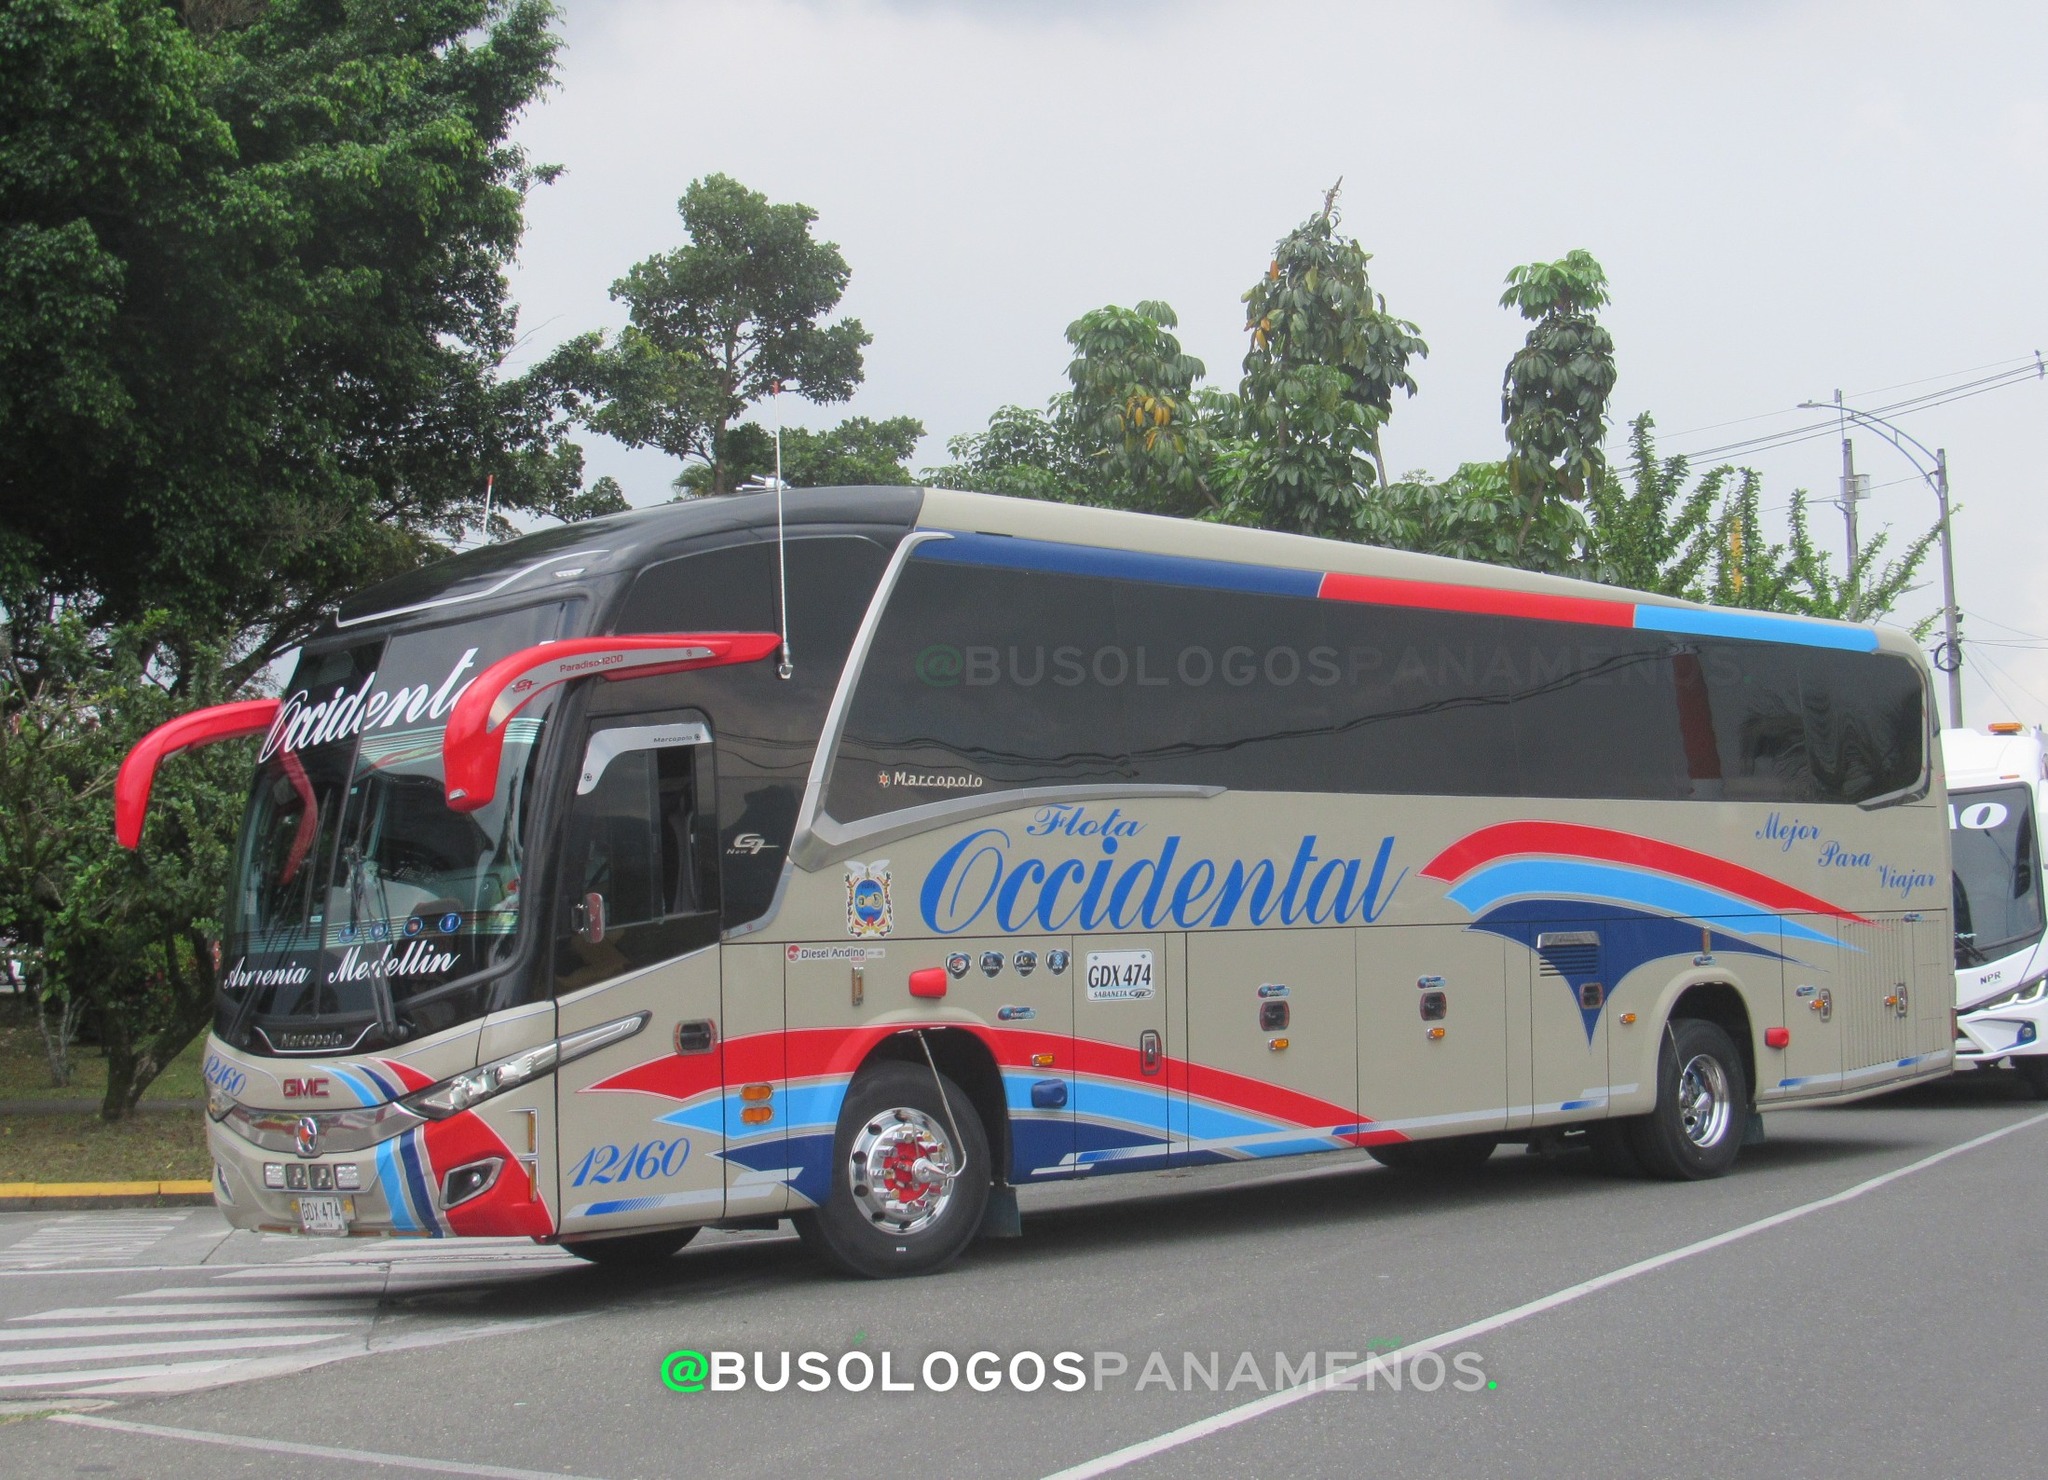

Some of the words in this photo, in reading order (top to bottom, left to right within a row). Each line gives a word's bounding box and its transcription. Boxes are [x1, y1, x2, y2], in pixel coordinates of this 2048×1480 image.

[560, 660, 600, 673] Paradiso
[258, 647, 480, 764] Occident
[653, 736, 693, 744] Marcopolo
[893, 771, 983, 789] Marcopolo
[1026, 803, 1150, 837] Flota
[1755, 812, 1822, 852] Mejor
[1817, 840, 1873, 868] Para
[919, 828, 1409, 935] Occidental
[1876, 865, 1937, 899] Viajar
[801, 948, 829, 959] Diesel
[831, 948, 865, 958] Andino
[1088, 965, 1120, 988] GDX
[1123, 963, 1151, 987] 474
[1980, 971, 2001, 985] NPR
[1094, 990, 1127, 998] SABANETA
[203, 1052, 247, 1097] 12160
[283, 1078, 329, 1097] GMC
[567, 1137, 691, 1188] 12160
[302, 1202, 318, 1221] GDX
[322, 1202, 341, 1220] 474
